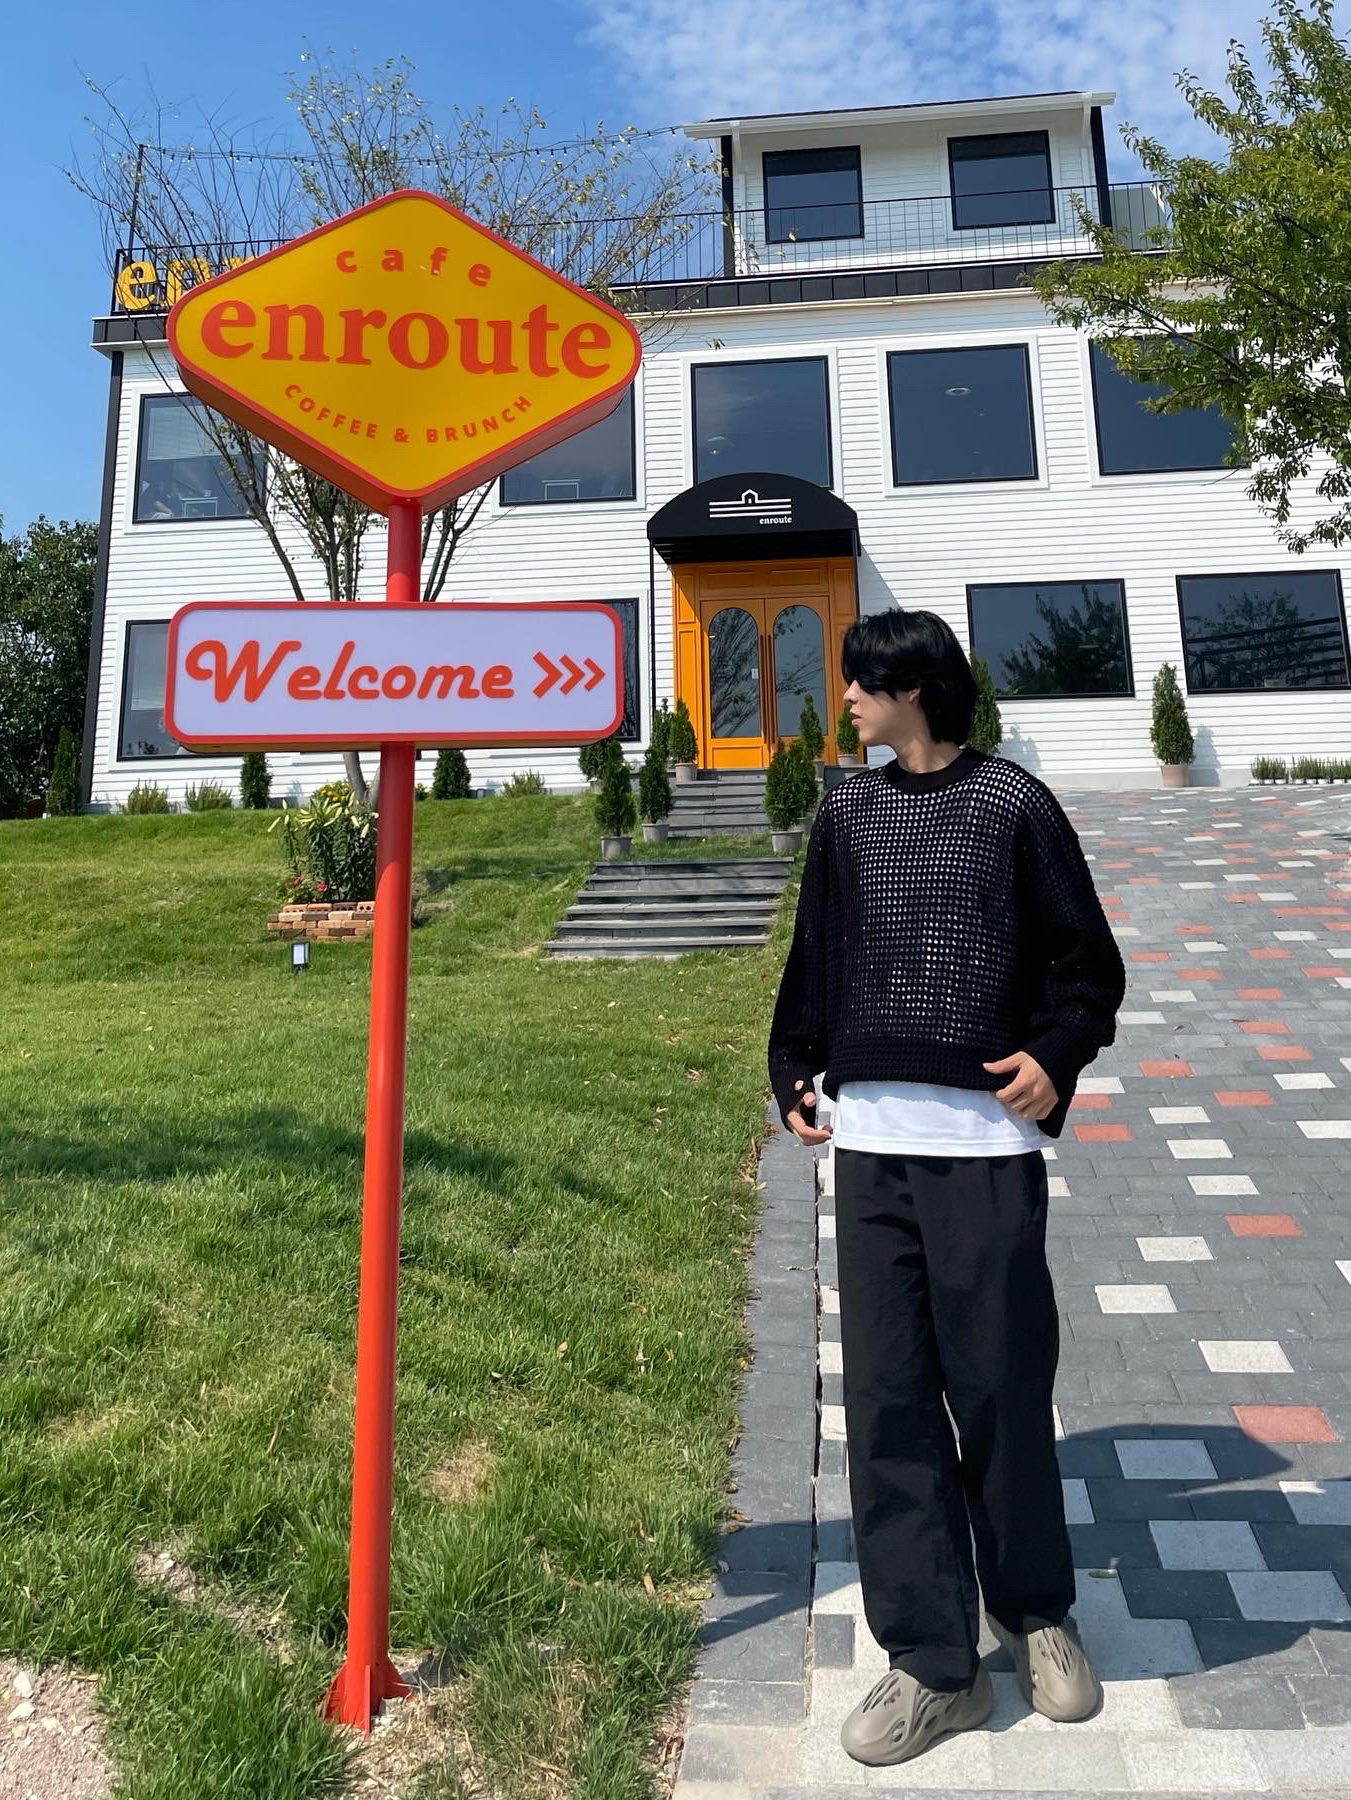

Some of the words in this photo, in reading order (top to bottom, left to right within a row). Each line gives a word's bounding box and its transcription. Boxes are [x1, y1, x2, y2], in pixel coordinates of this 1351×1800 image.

[335, 246, 493, 288] cafe
[200, 299, 612, 380] enroute
[284, 383, 379, 440] COFFEE
[393, 426, 410, 444] &
[426, 395, 532, 443] BRUNCH
[759, 516, 792, 525] enroute
[184, 639, 515, 703] Welcome
